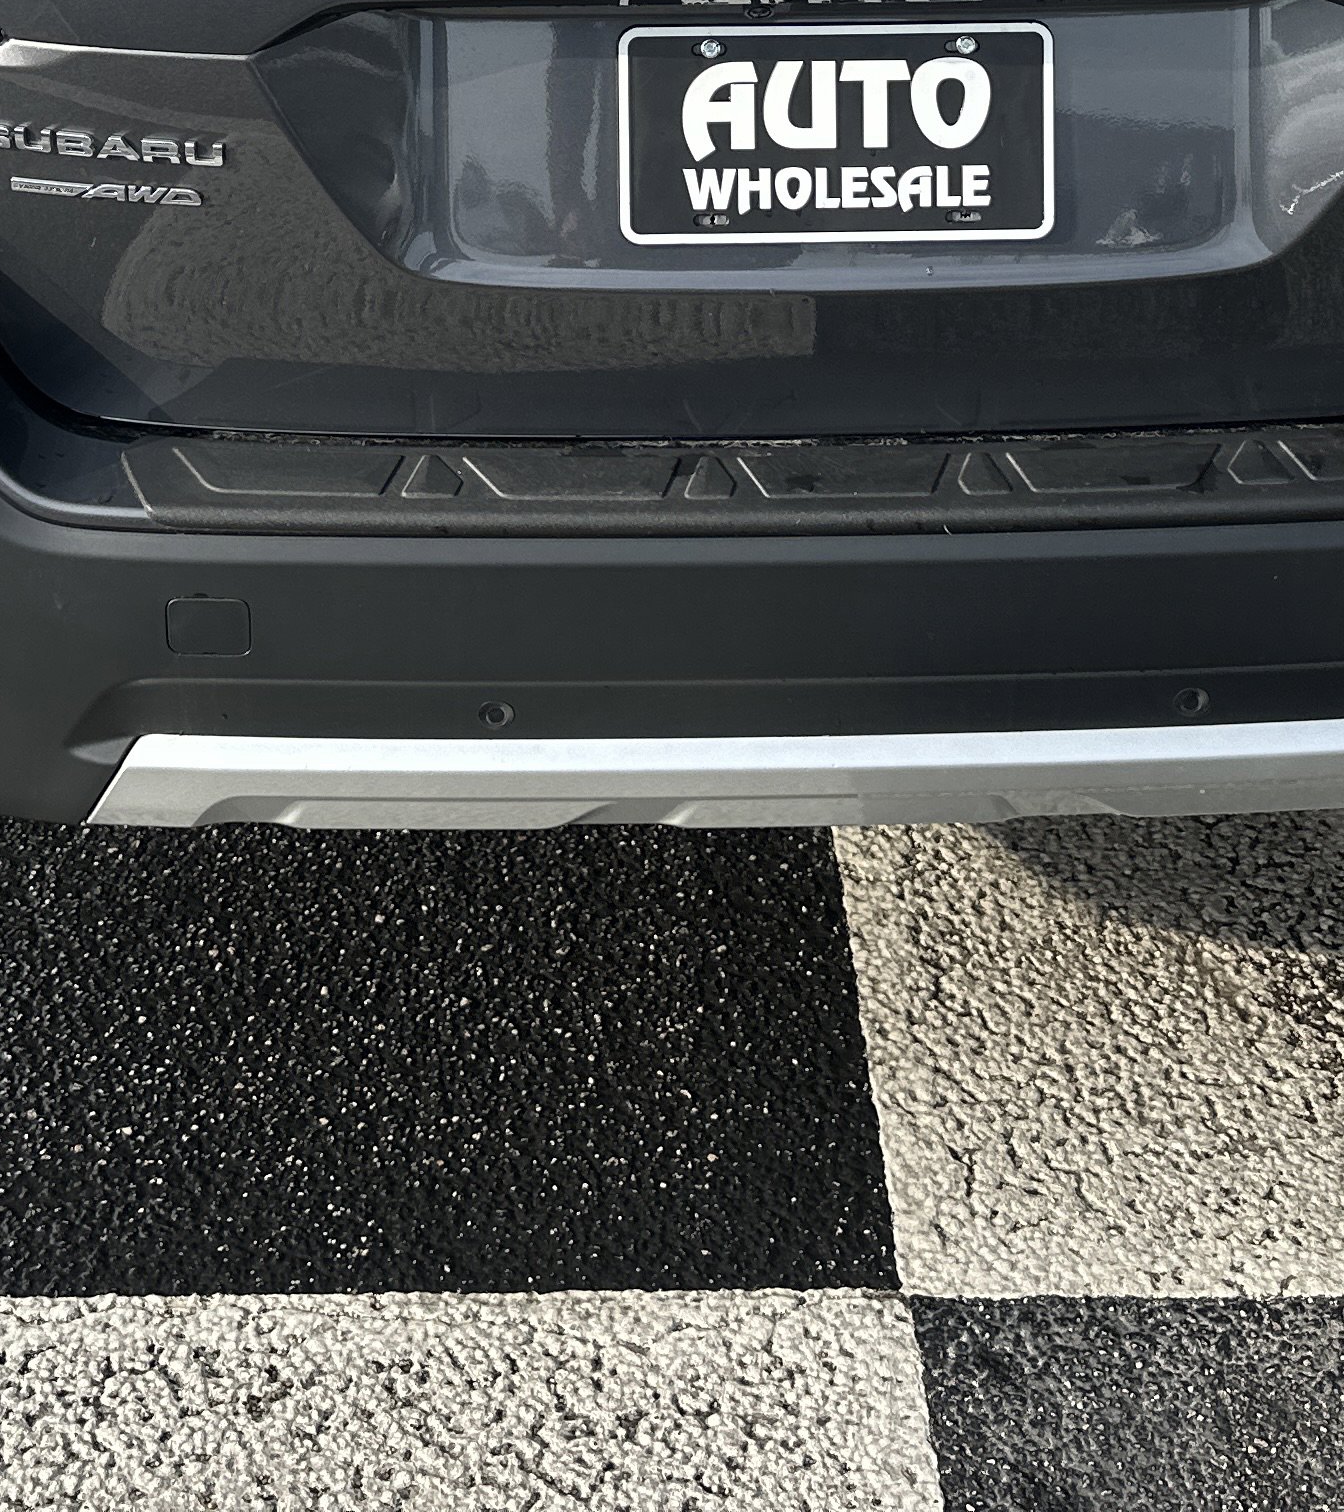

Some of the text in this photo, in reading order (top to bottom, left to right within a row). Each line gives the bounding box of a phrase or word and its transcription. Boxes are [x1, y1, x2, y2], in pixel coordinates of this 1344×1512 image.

[682, 56, 991, 162] AUTO
[81, 184, 203, 207] AWD
[682, 164, 992, 215] WHOLESALE
